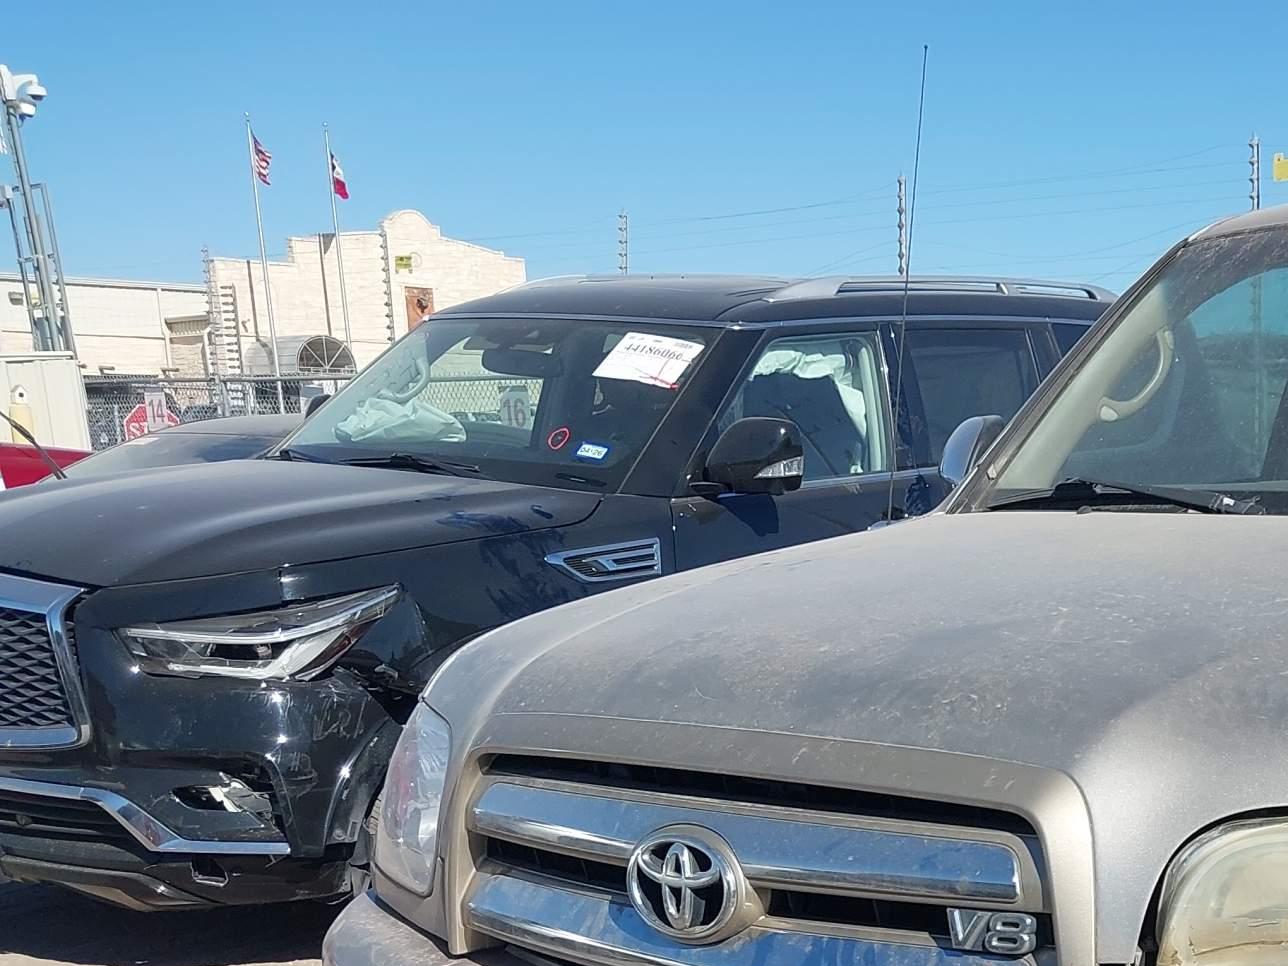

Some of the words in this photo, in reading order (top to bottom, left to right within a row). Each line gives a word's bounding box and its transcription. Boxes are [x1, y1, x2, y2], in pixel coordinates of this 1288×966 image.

[148, 398, 166, 424] 14
[502, 398, 527, 428] 16
[946, 907, 1038, 955] V8
